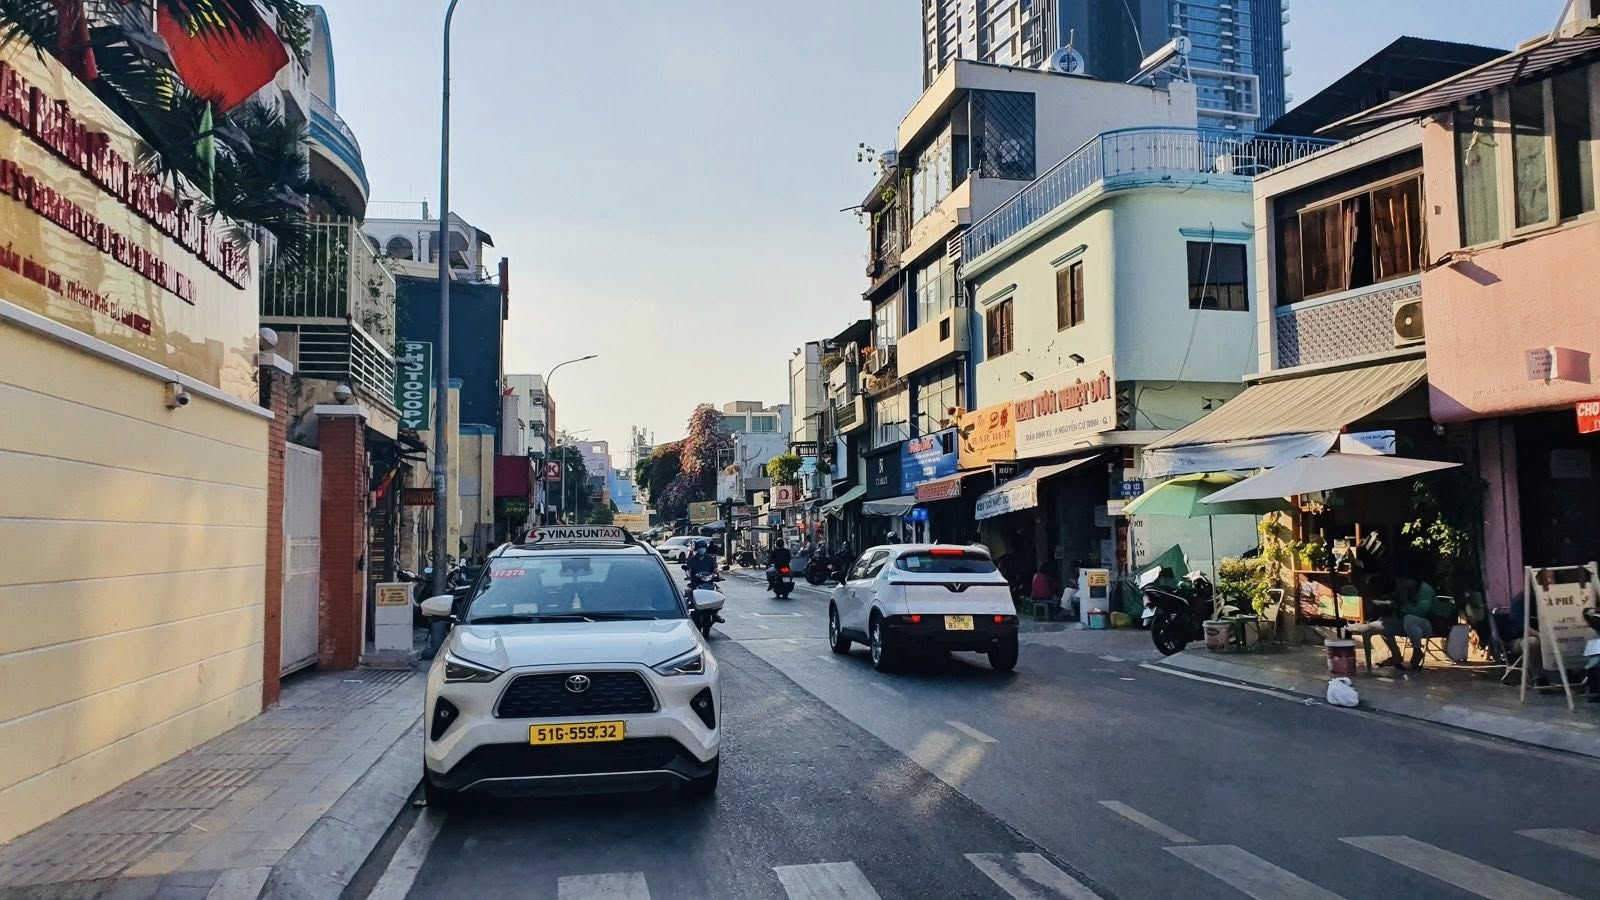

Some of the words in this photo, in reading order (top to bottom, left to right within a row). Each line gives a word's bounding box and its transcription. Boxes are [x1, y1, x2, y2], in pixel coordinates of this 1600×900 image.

[1578, 402, 1600, 417] CHO
[547, 529, 620, 538] VINASUNTAXI
[538, 725, 617, 741] 51G-559.32
